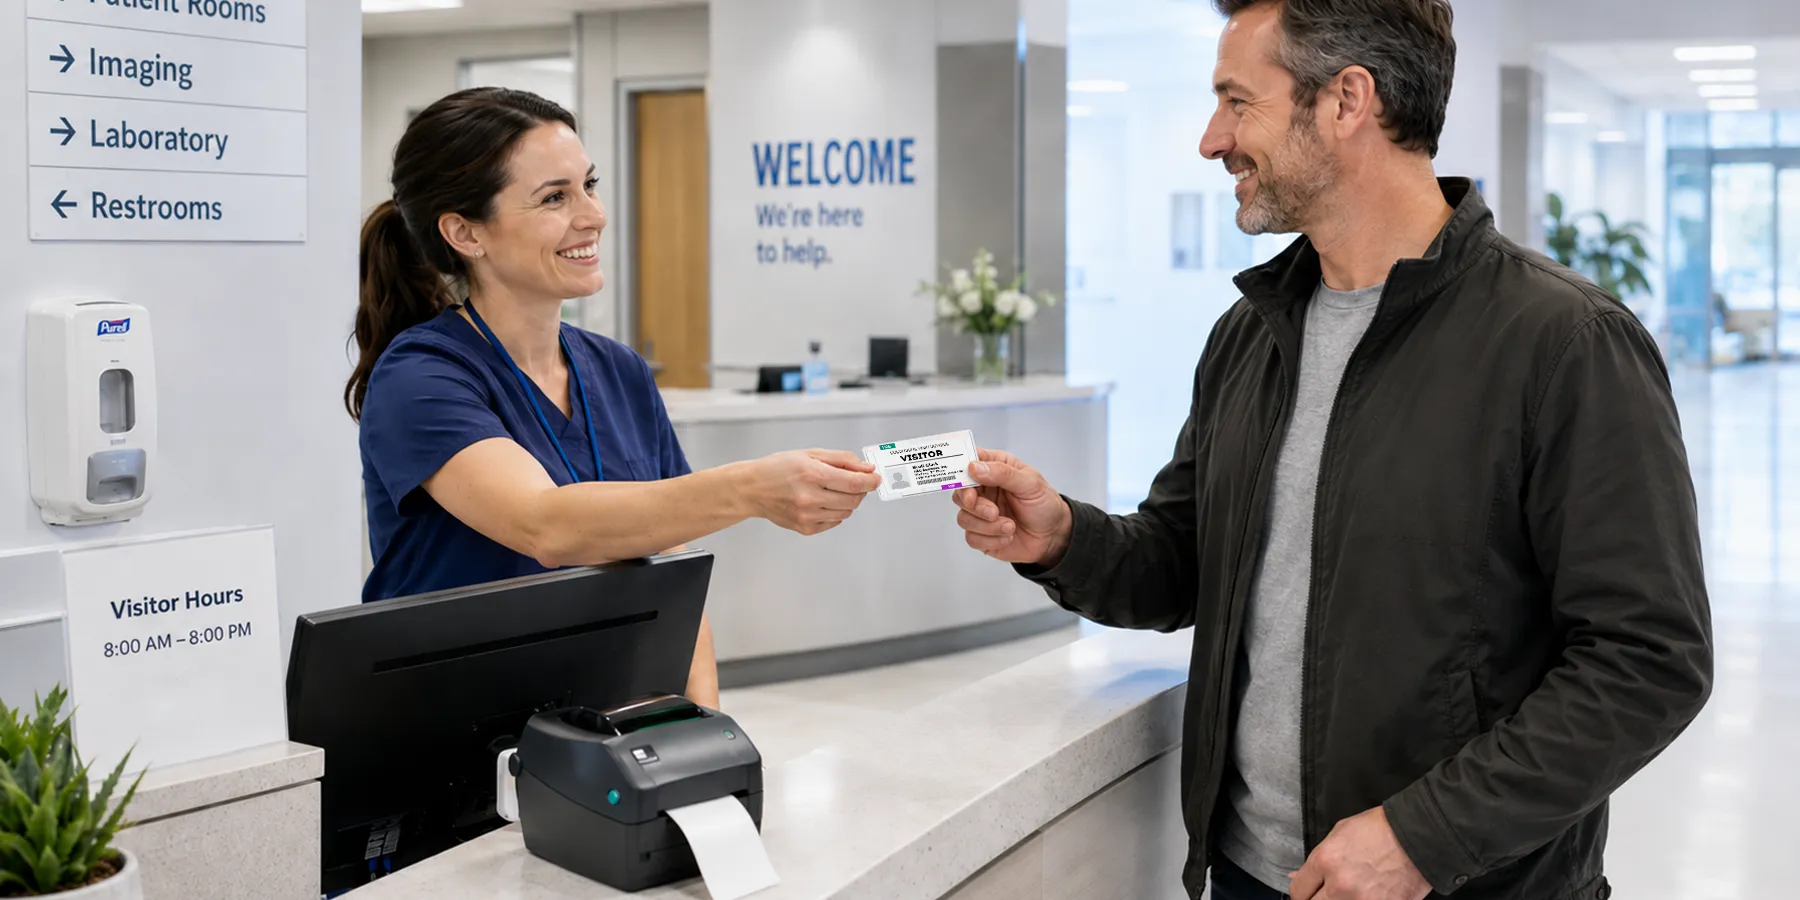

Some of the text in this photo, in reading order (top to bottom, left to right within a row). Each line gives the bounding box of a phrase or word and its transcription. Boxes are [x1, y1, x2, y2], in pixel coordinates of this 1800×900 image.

[188, 0, 266, 23] Rooms
[91, 48, 192, 90] Imaging
[91, 119, 228, 160] Laboratory
[752, 137, 916, 187] WELCOME
[92, 192, 222, 220] Restrooms
[755, 202, 864, 228] We're here
[755, 237, 833, 270] to help.
[100, 321, 128, 333] Purell
[900, 450, 943, 461] VISITOR
[111, 589, 243, 620] Visitor Hours
[104, 639, 140, 657] 8:00
[146, 634, 171, 651] AM
[189, 627, 223, 645] 8:00
[229, 622, 251, 639] PM
